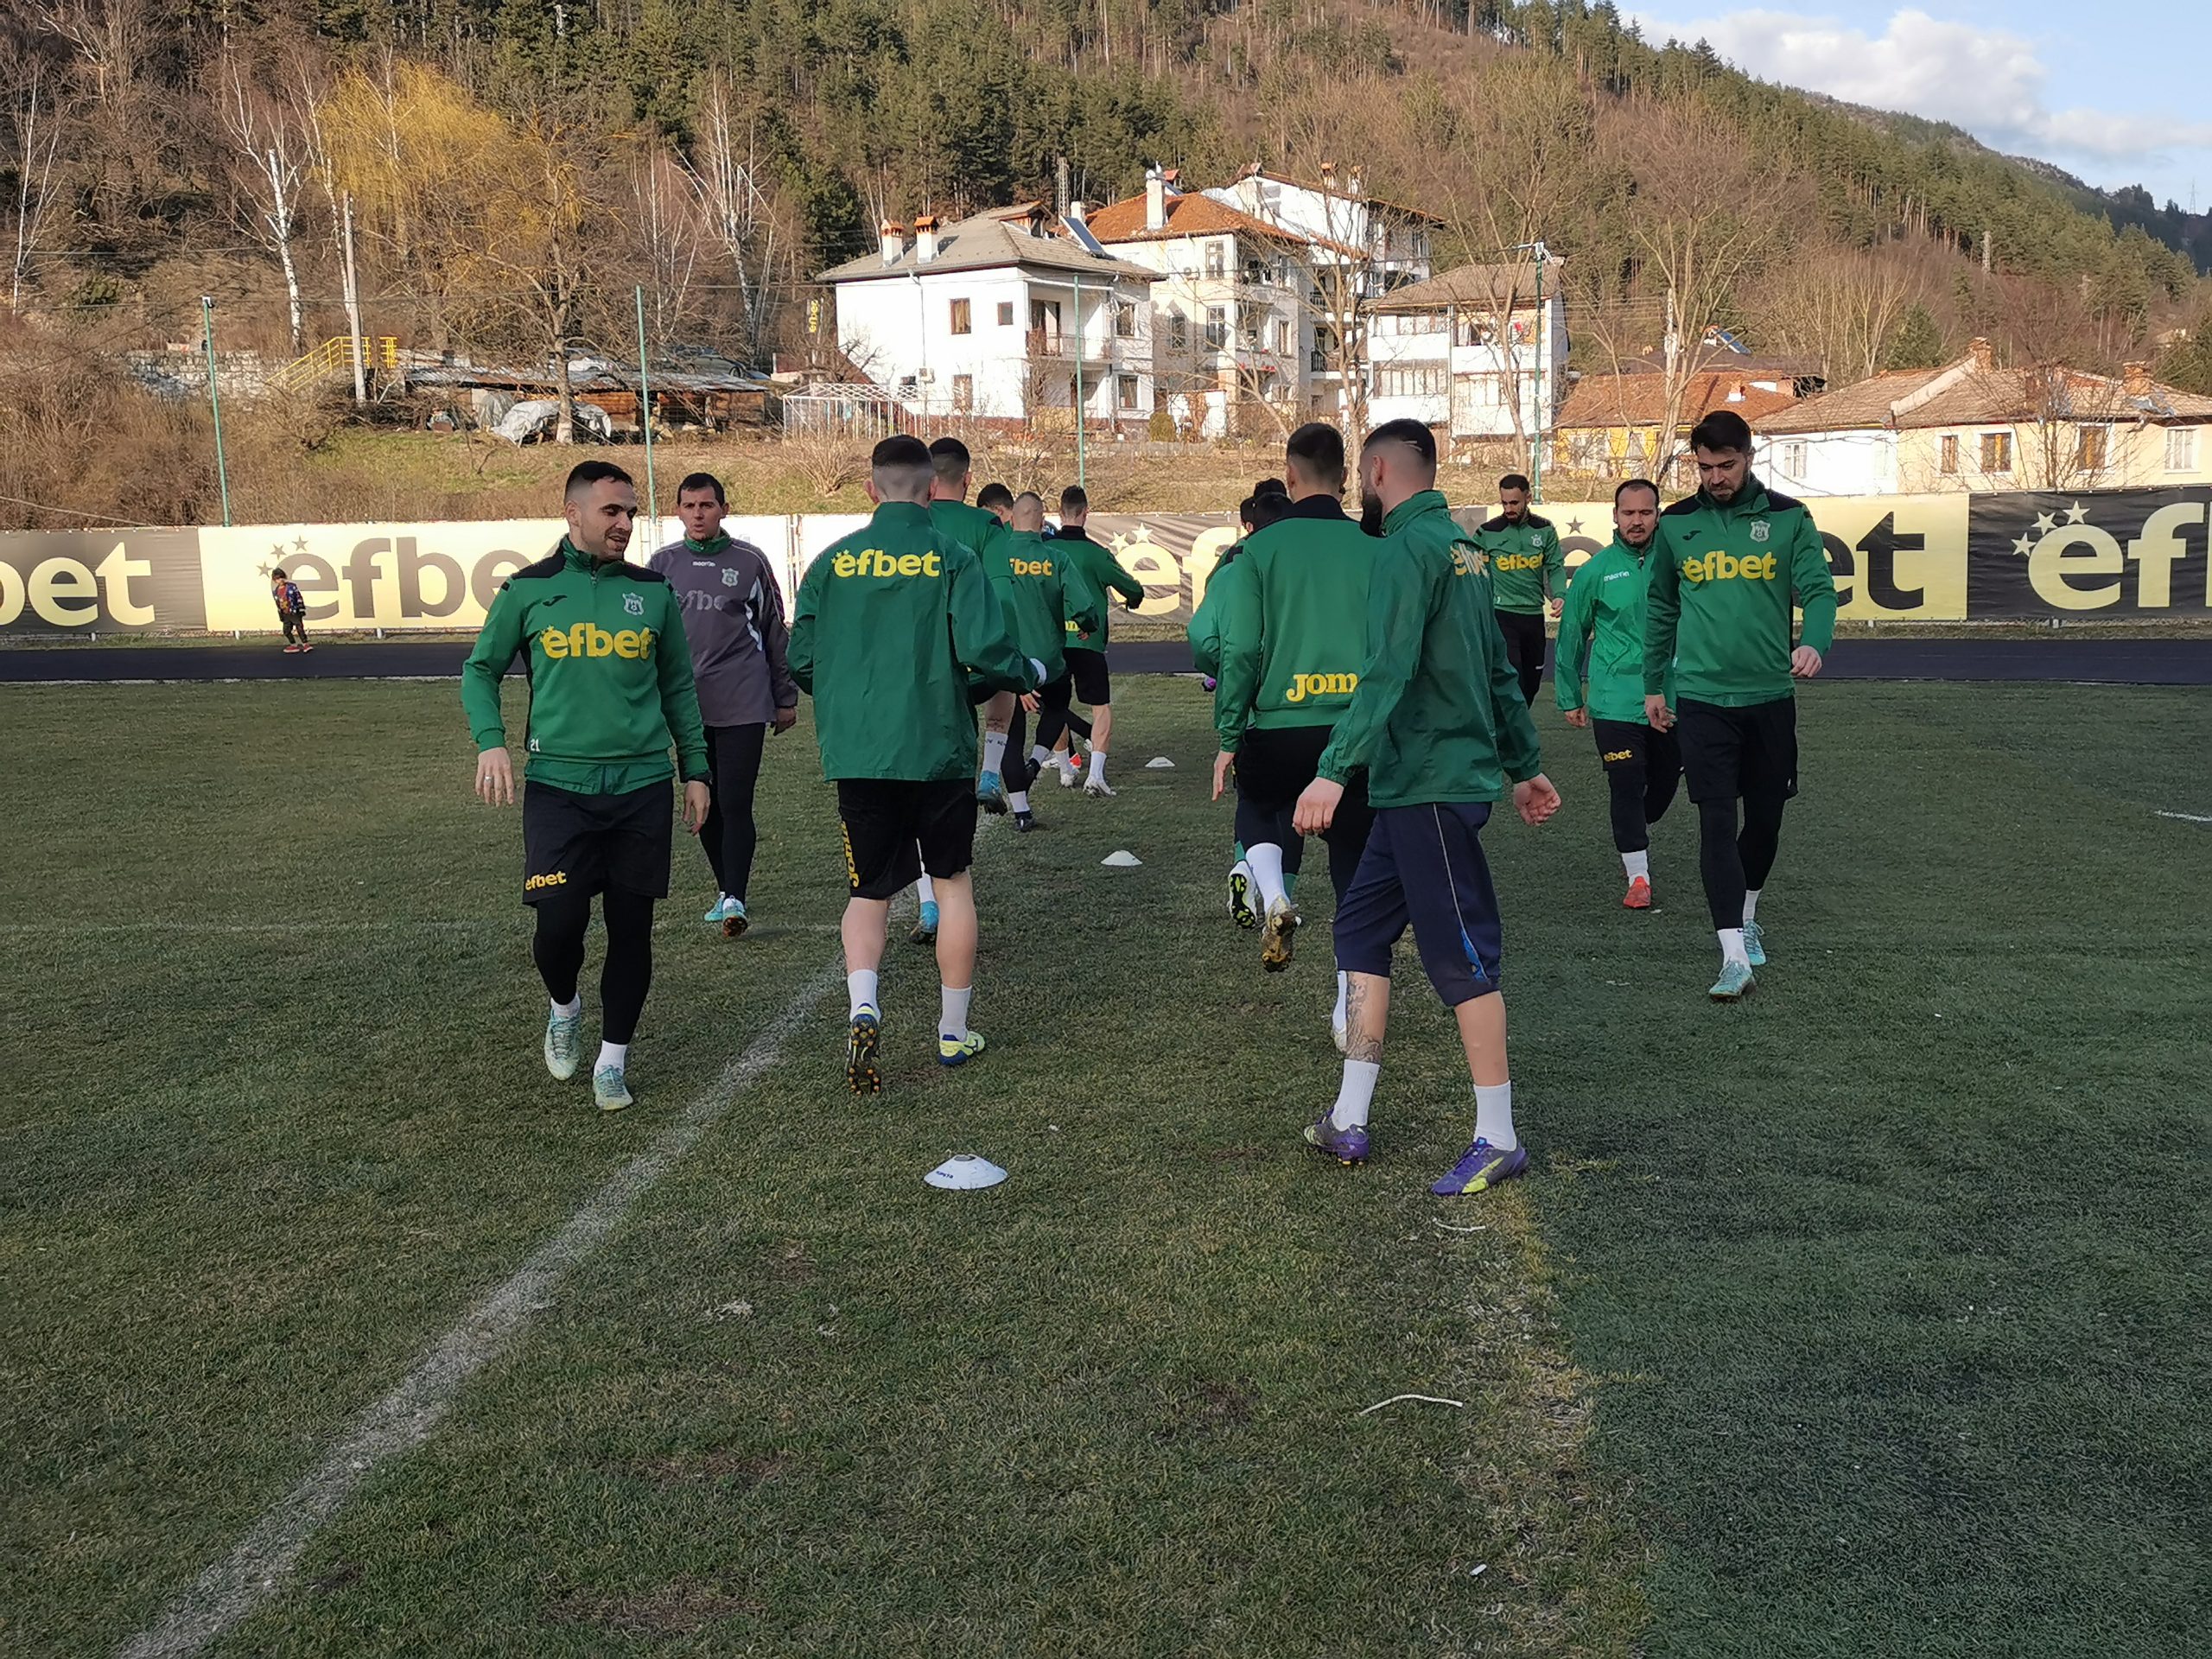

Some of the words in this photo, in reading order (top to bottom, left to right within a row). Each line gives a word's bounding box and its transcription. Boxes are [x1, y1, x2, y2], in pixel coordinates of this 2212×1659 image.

[834, 549, 941, 577] efbet
[1683, 550, 1777, 583] efbet
[2028, 501, 2212, 610] ef
[271, 537, 563, 620] efbe
[542, 622, 652, 659] efbet
[530, 739, 541, 752] 21
